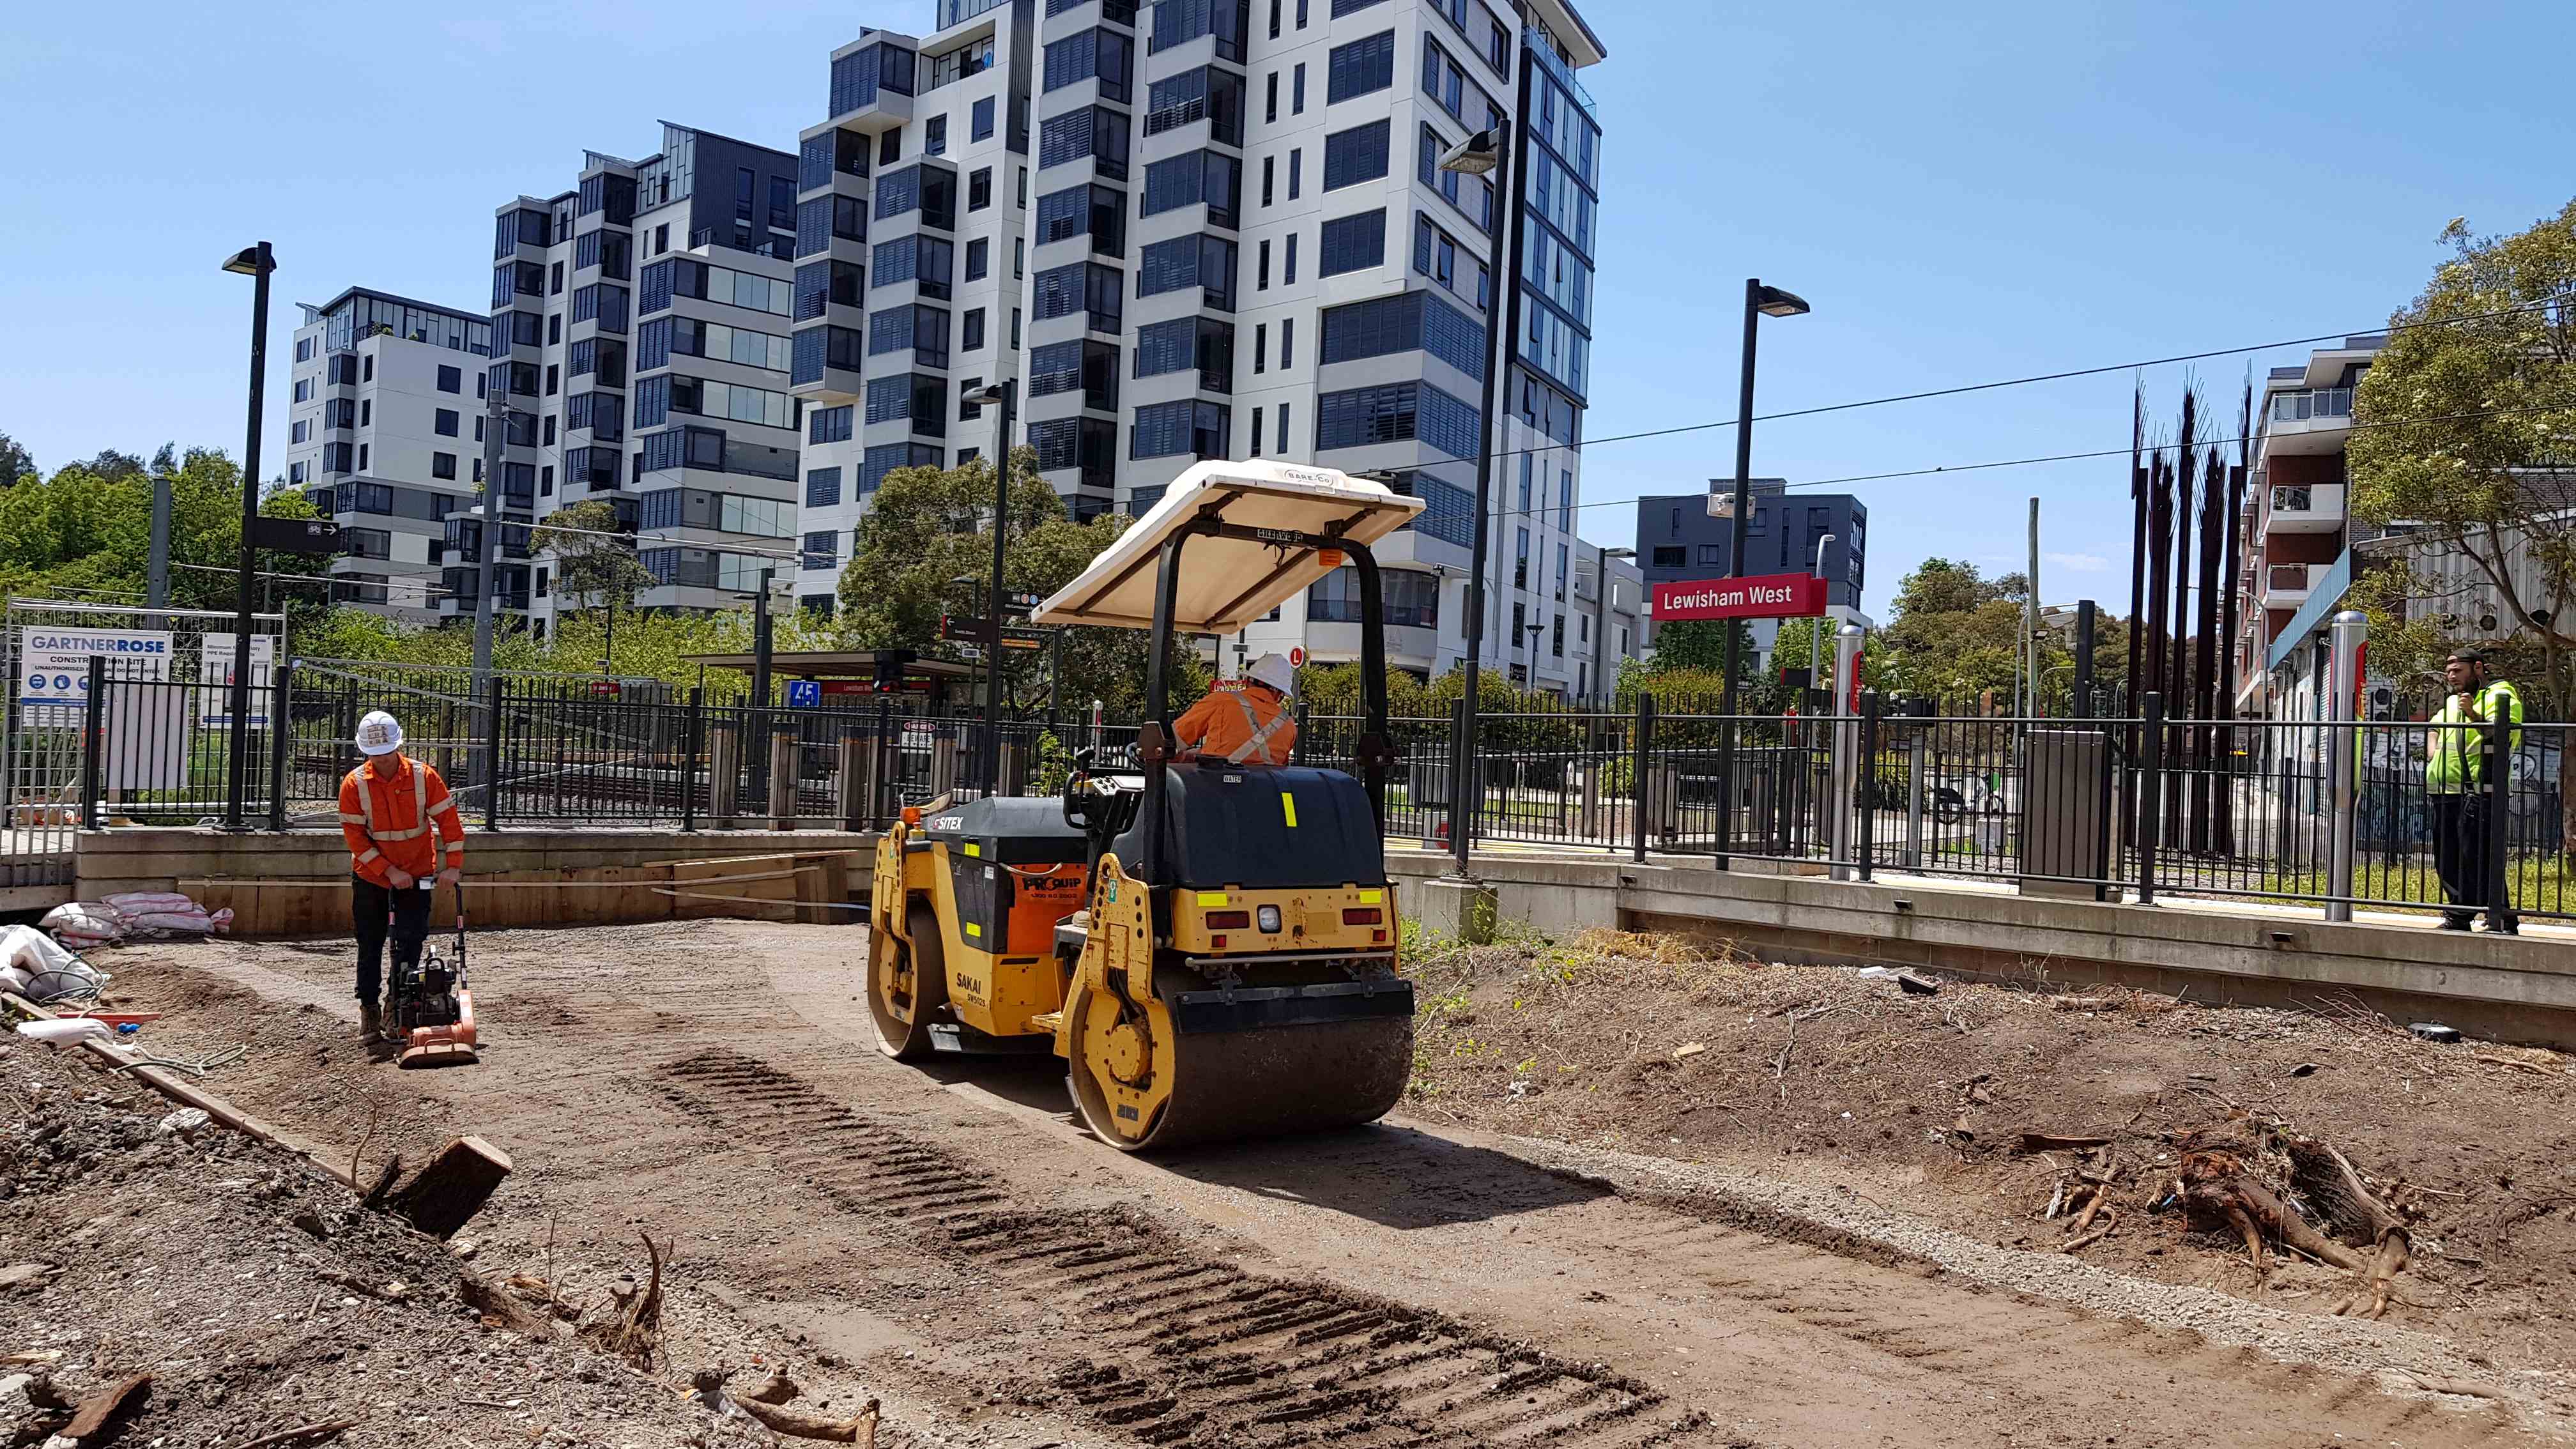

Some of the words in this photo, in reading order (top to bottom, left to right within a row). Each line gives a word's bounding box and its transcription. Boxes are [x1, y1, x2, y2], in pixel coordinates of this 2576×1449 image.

[1664, 589, 1744, 610] Lewisham
[1749, 585, 1792, 604] West
[32, 636, 165, 653] GARTNERROSE
[1293, 650, 1300, 663] L
[956, 972, 981, 995] SAKAI
